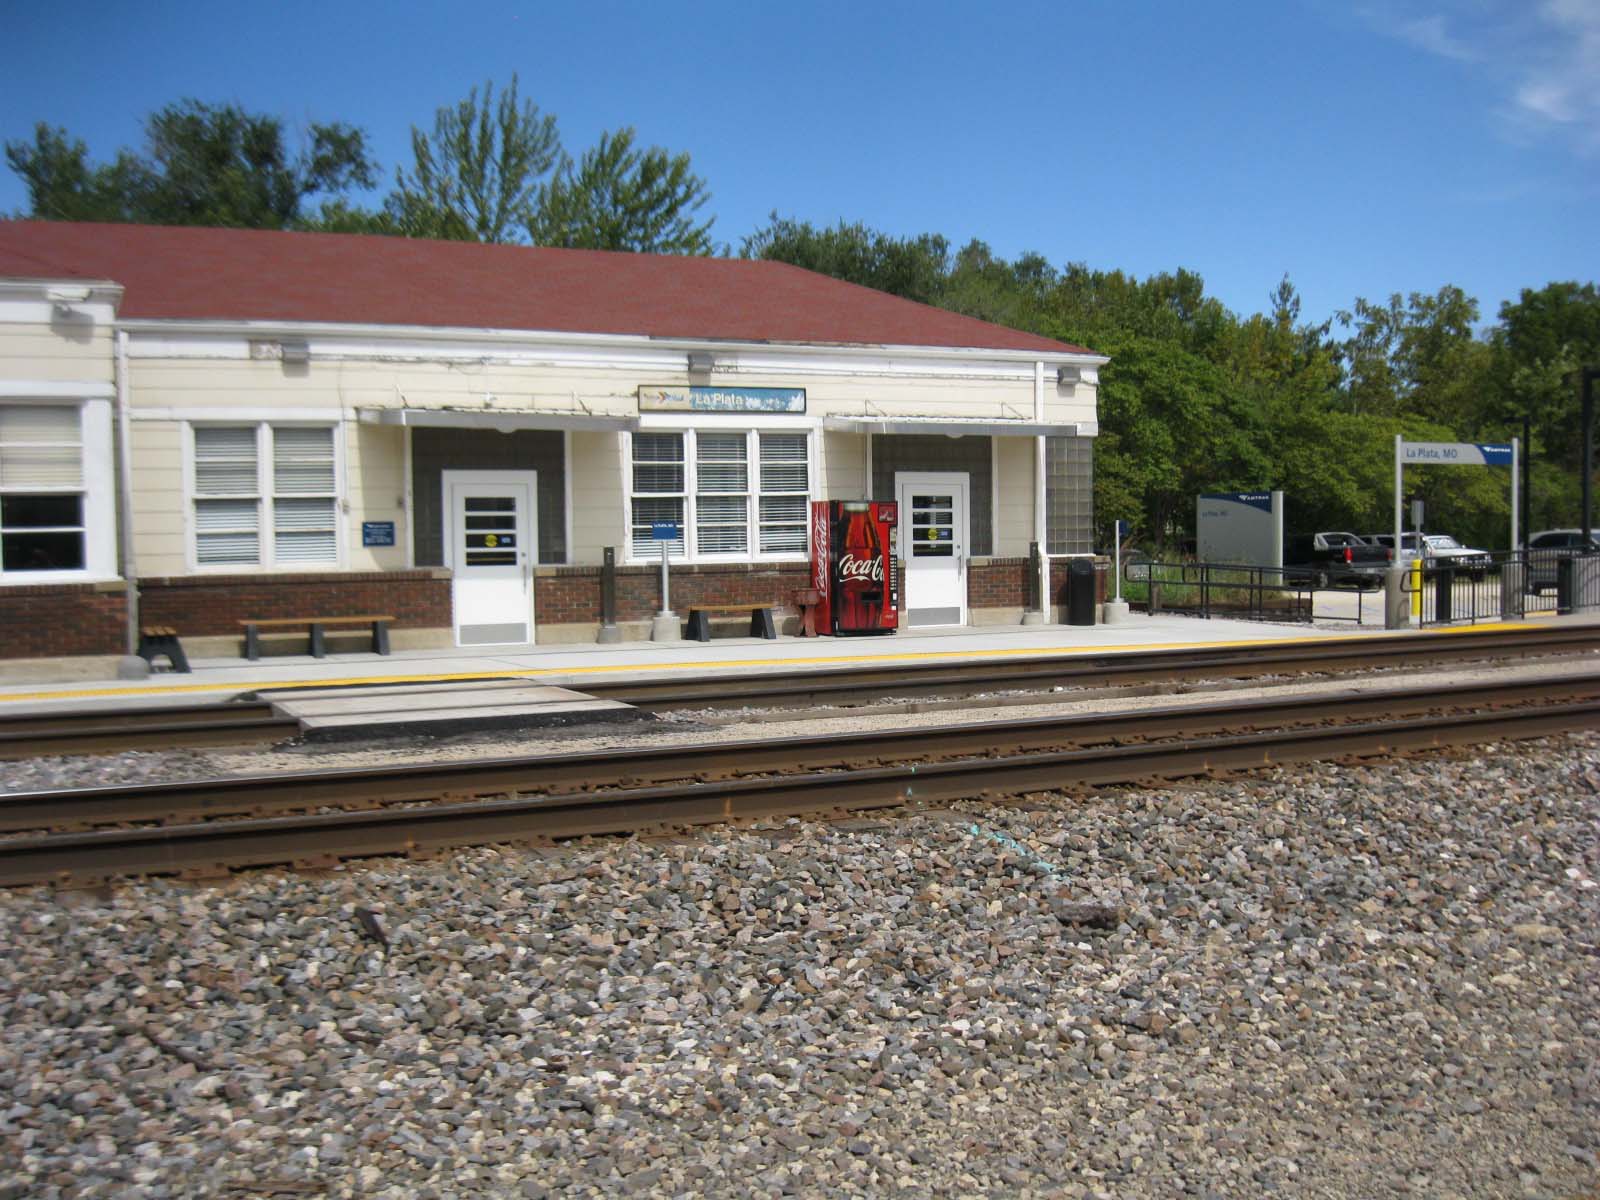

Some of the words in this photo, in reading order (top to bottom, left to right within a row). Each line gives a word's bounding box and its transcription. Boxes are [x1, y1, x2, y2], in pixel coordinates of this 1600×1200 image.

[695, 392, 711, 405] La
[713, 391, 743, 405] Plata
[1406, 447, 1417, 458] La
[1443, 447, 1458, 459] MO
[815, 513, 827, 598] Coca-Cola
